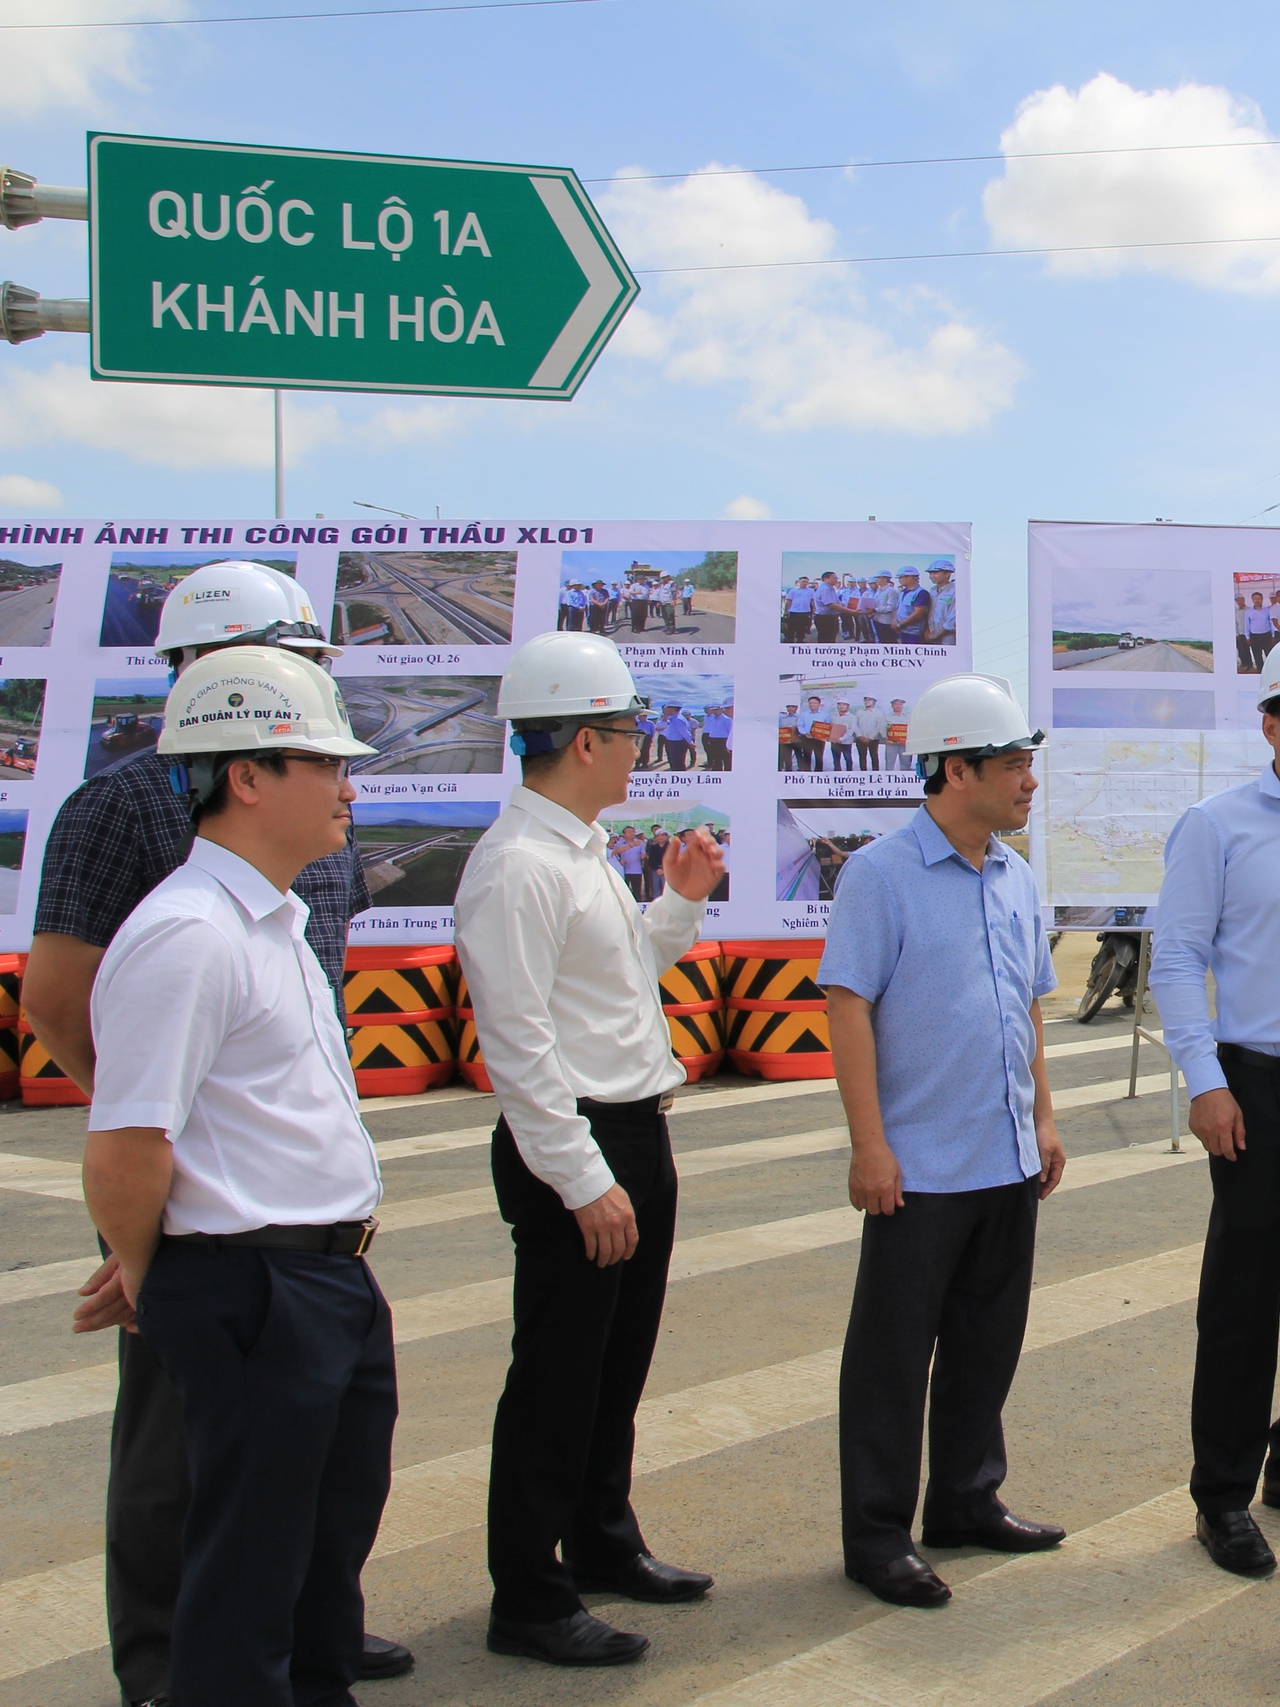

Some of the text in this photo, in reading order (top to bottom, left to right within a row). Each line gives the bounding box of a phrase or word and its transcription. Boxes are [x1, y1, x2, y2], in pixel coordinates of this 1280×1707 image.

[148, 179, 492, 261] QUỐC LỘ 1A
[151, 275, 506, 346] KHÁNH HÒA
[0, 521, 594, 545] HÌNH ẢNH THI CÔNG GÓI THẦU XL01
[195, 590, 231, 600] LIZEN
[625, 646, 656, 657] Phạm
[659, 646, 688, 656] Minh
[691, 646, 725, 656] Chính
[789, 645, 947, 657] Thủ tướng Phạm Minh Chính
[126, 656, 145, 666] Thi
[377, 654, 460, 666] Nút giao QL 26
[634, 660, 650, 668] tra
[653, 659, 668, 670] dự
[671, 659, 684, 668] án
[812, 658, 925, 669] trao quà cho CBCNV
[179, 715, 199, 728] BAN
[202, 708, 233, 723] QUẢN
[237, 708, 250, 719] LÝ
[294, 713, 302, 721] 7
[671, 775, 693, 786] Duy
[697, 774, 722, 784] Lâm
[784, 774, 921, 786] Phó Thủ tướng Lê Thành
[360, 782, 457, 795] Nút giao Vạn Giã
[629, 788, 680, 799] tra dự án
[828, 785, 908, 799] kiểm tra dự án
[807, 904, 830, 914] Bí th
[369, 918, 399, 928] Thân
[403, 918, 437, 930] Trung
[441, 918, 455, 927] Th
[782, 918, 819, 930] Nghiêm
